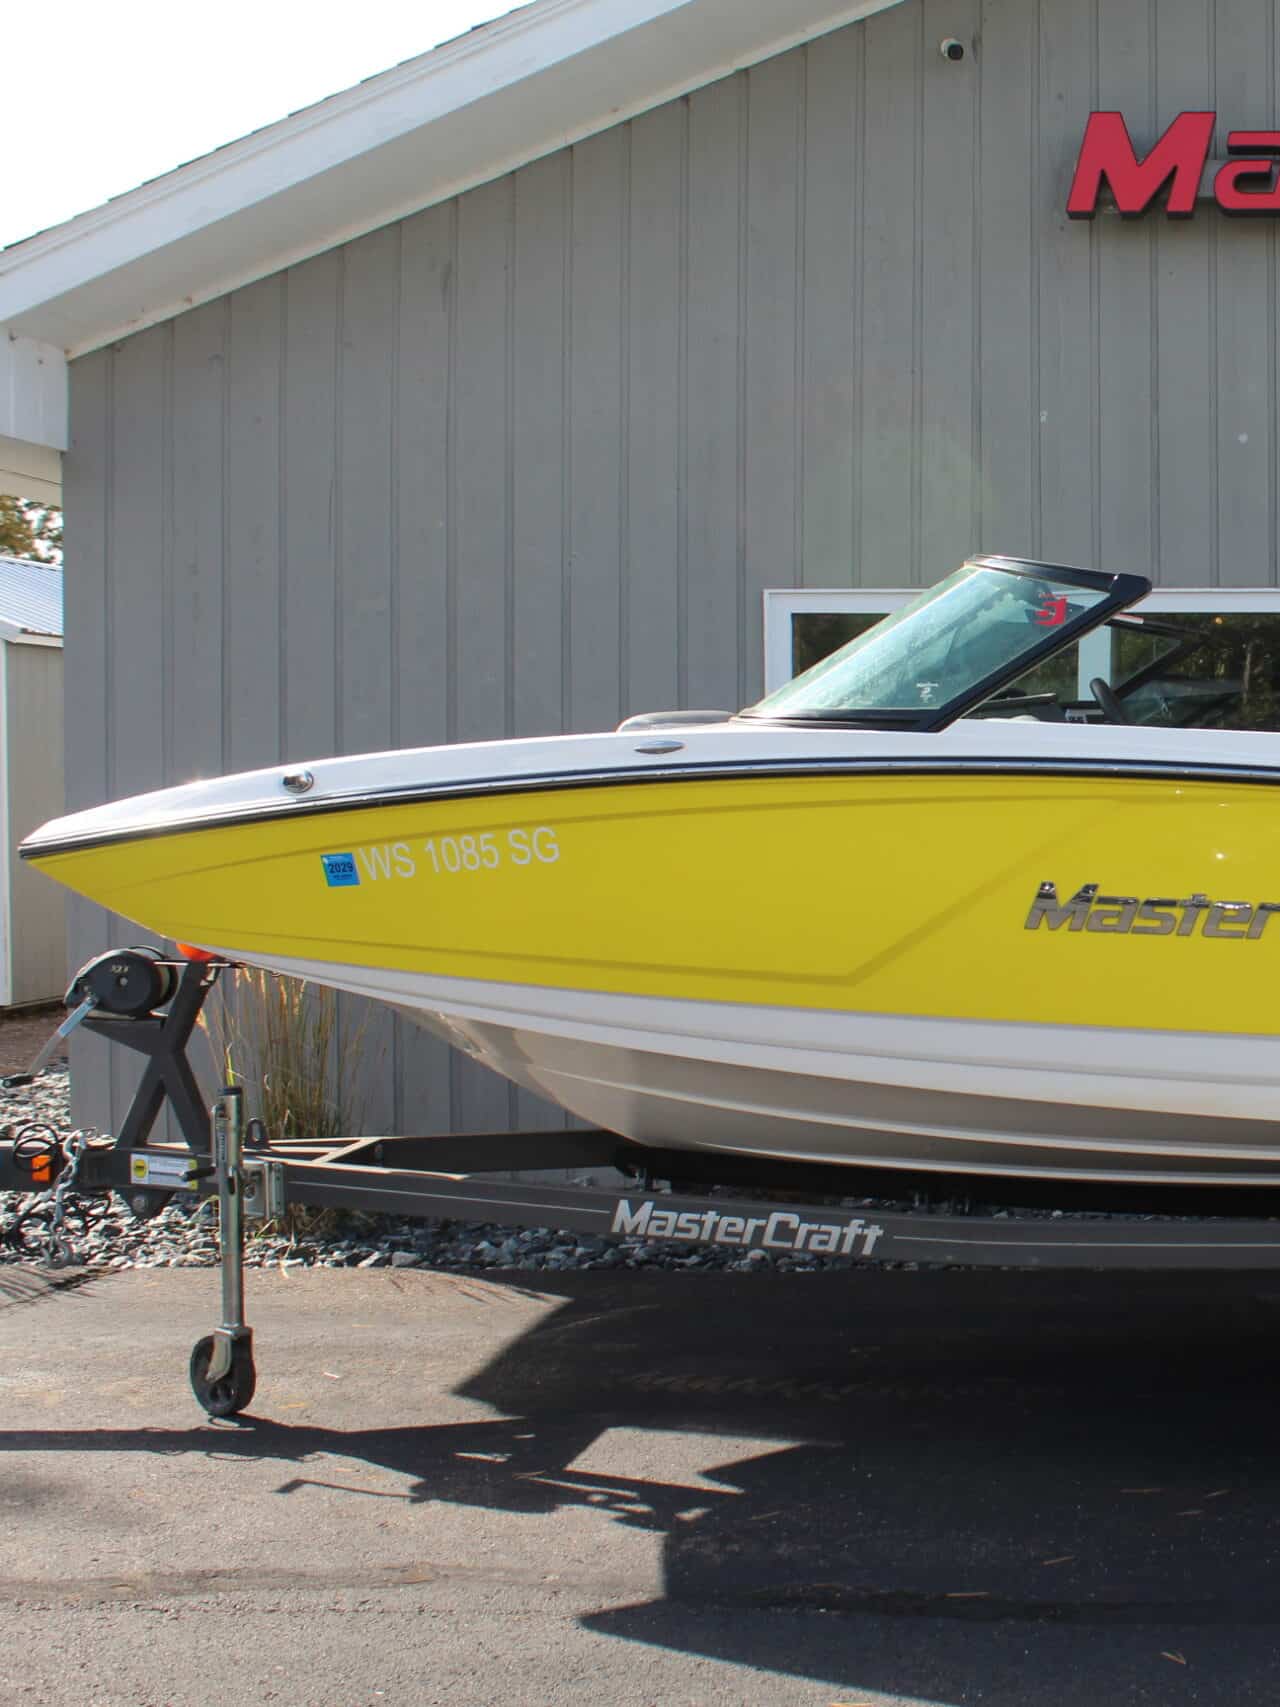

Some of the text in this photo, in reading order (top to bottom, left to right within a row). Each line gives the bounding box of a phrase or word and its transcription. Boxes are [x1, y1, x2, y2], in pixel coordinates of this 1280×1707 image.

[358, 826, 560, 880] WS 1085 SG
[611, 1199, 884, 1255] MasterCraft
